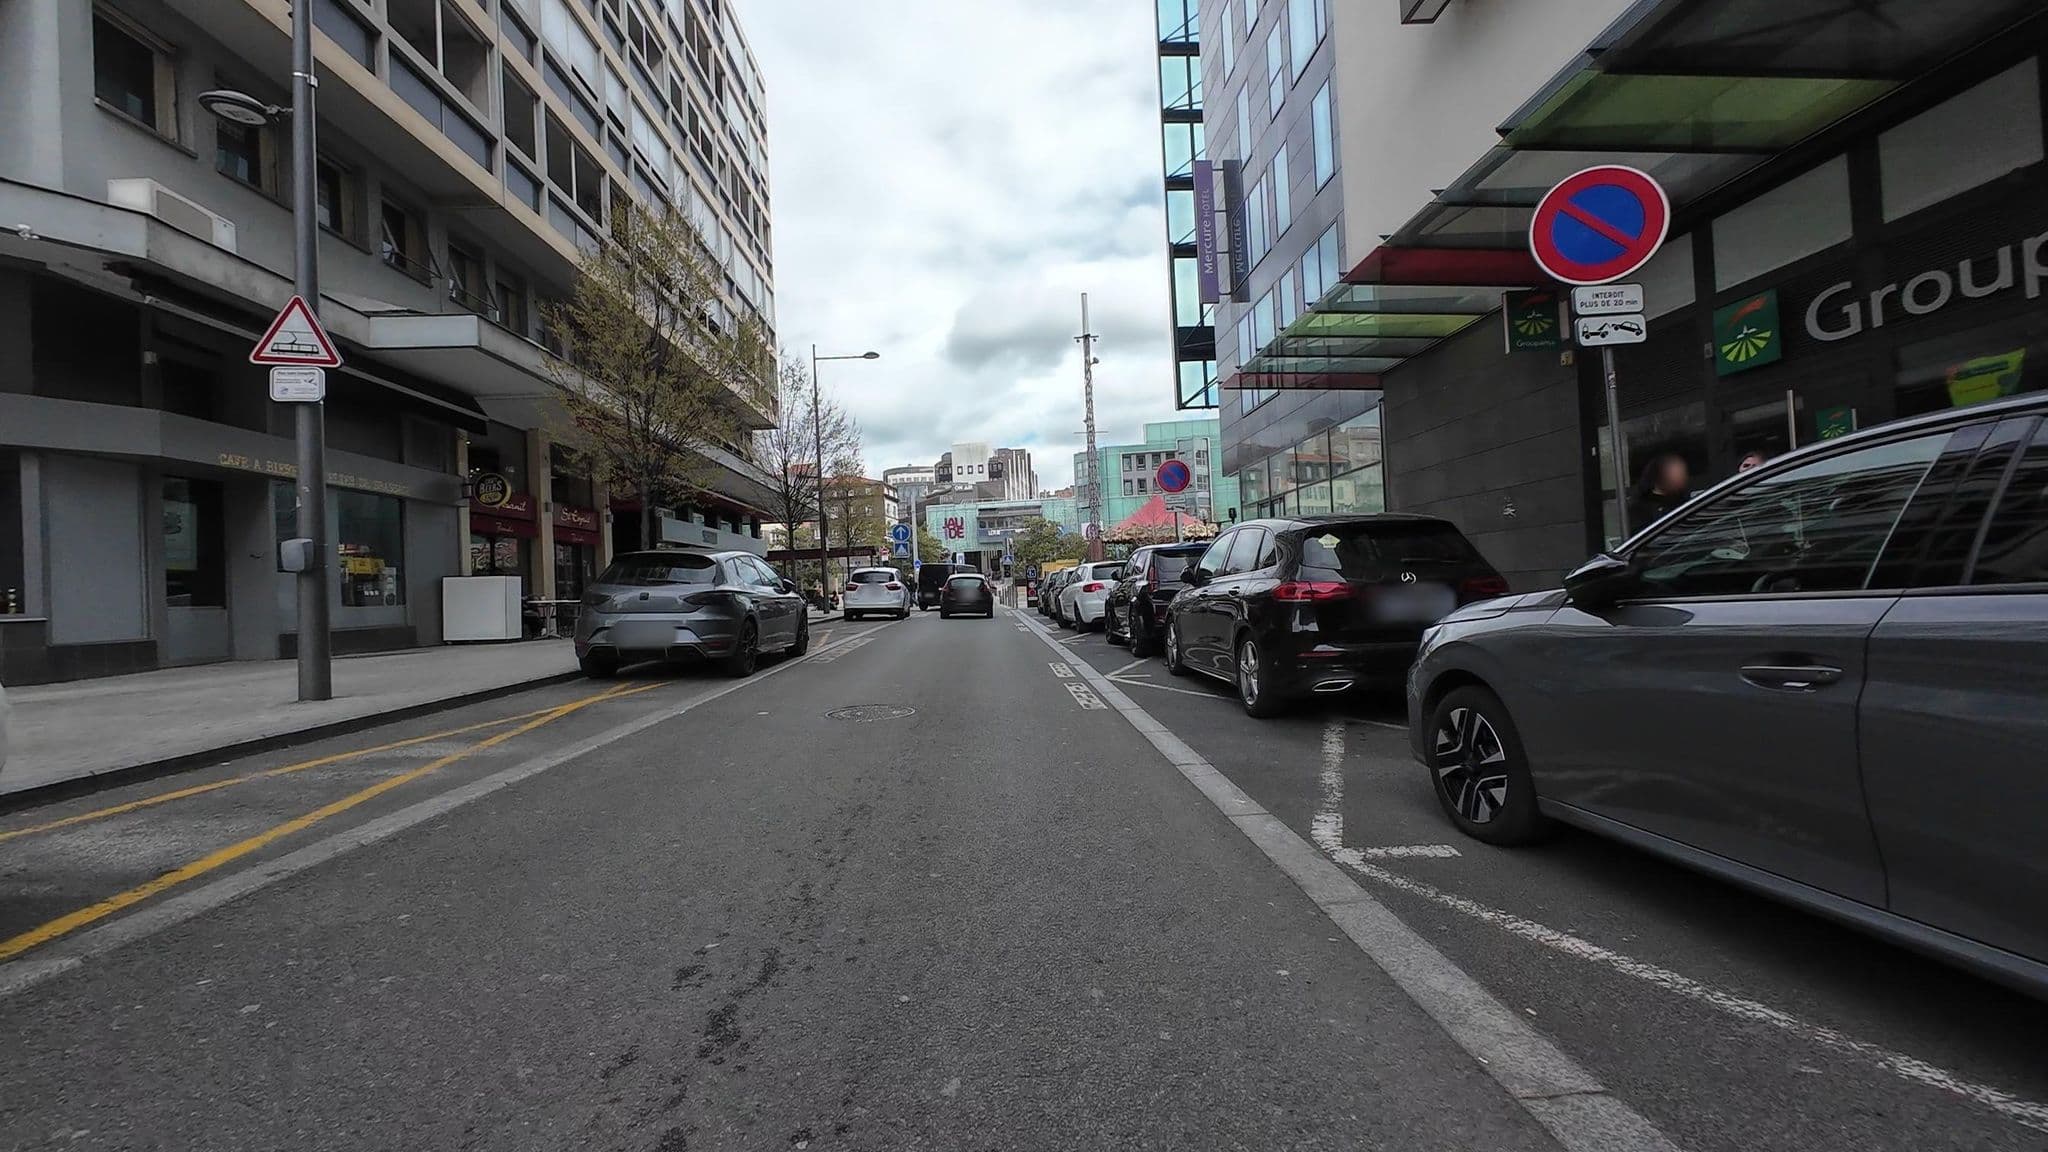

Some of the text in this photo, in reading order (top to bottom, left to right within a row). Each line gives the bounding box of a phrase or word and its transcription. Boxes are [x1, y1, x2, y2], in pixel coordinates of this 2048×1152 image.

[1201, 187, 1214, 274] Mercure HOTEL
[1592, 291, 1624, 299] INTERDIT
[1580, 300, 1598, 308] PLUS
